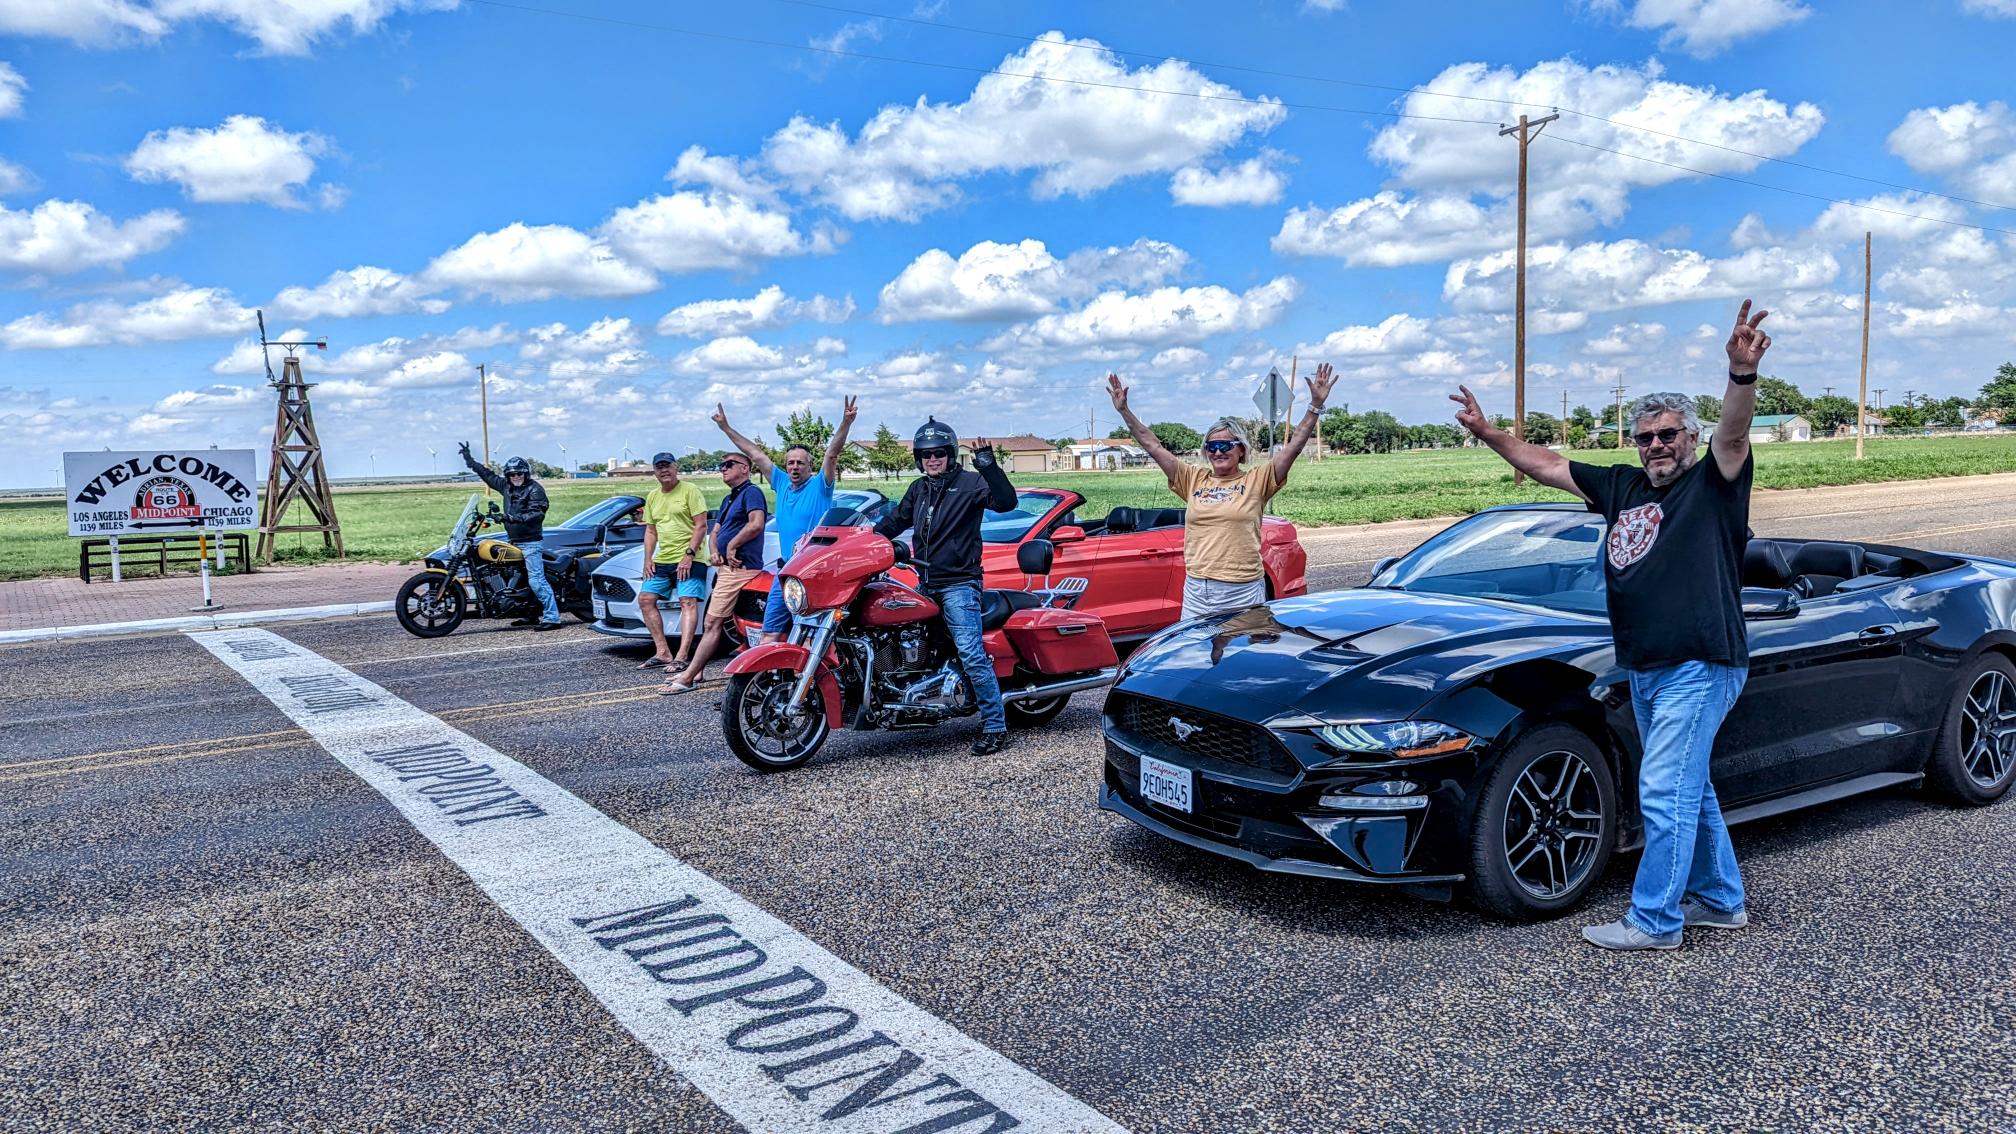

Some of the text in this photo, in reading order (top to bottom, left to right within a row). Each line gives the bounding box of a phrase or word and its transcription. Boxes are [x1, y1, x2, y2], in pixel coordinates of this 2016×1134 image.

[75, 454, 251, 505] WELCOME
[170, 477, 193, 496] TEXAS
[153, 495, 177, 505] 66
[73, 510, 129, 522] LOS ANGELES
[137, 507, 196, 518] MIDPOINT
[203, 506, 253, 517] CHICAGO
[79, 521, 124, 532] 1139 MILES
[208, 517, 252, 527] 1139 MILES
[363, 740, 549, 827] MIDPOINT
[570, 893, 1020, 1134] MIDPOINT
